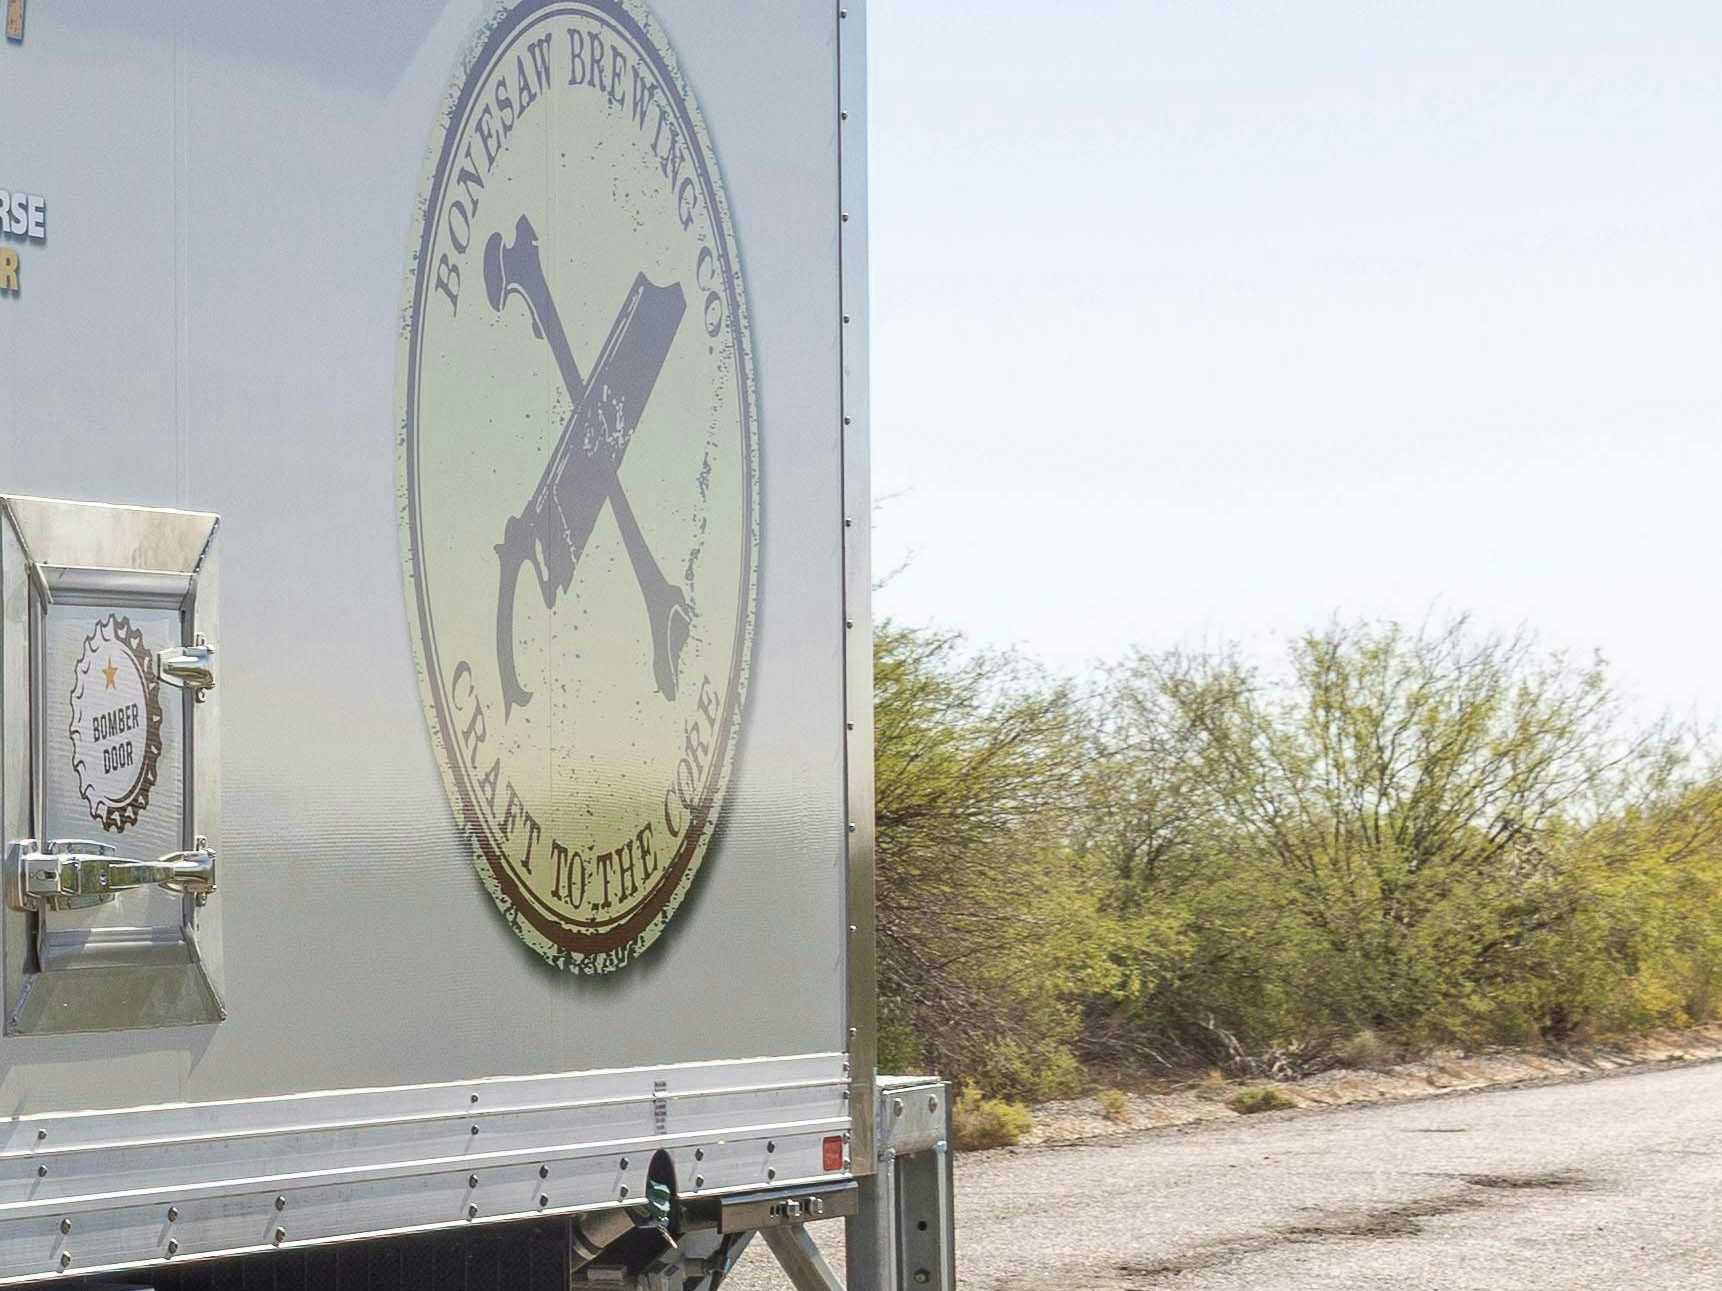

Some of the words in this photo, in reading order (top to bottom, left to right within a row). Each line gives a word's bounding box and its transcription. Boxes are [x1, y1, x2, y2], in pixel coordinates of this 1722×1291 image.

[434, 31, 553, 317] BONESAW
[567, 27, 699, 232] BREWING
[92, 703, 140, 743] BOMBER
[103, 740, 134, 775] DOOR
[451, 659, 542, 875] CRAFT
[550, 842, 585, 910] TO
[597, 822, 660, 910] THE
[664, 673, 722, 839] CORE
